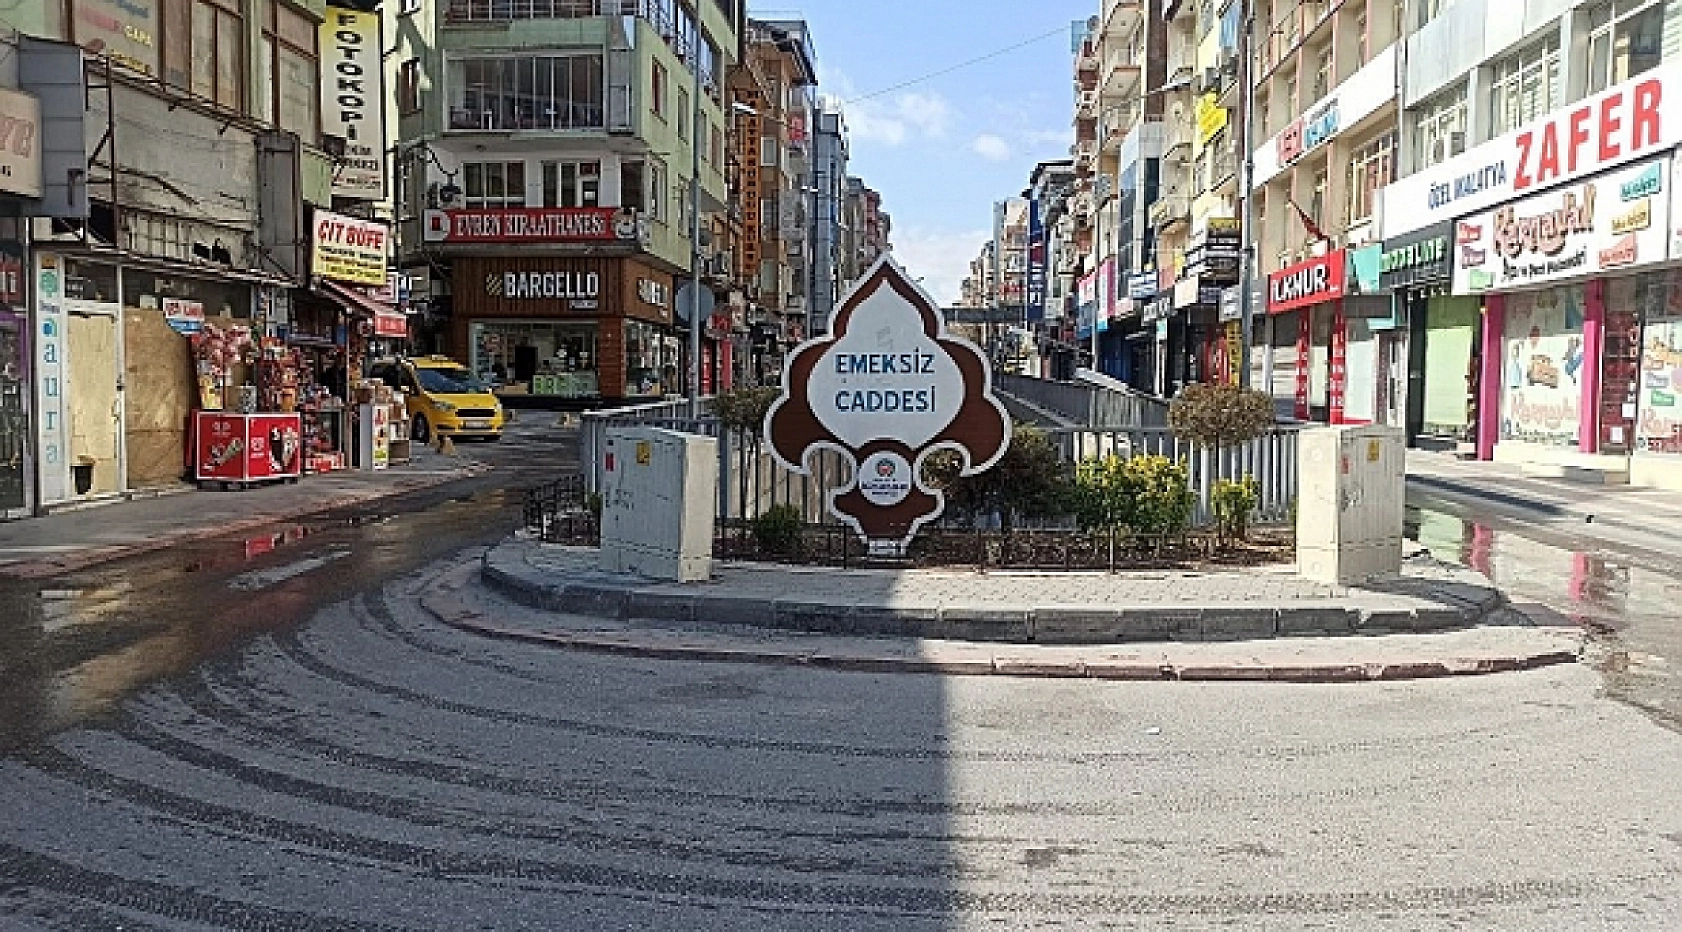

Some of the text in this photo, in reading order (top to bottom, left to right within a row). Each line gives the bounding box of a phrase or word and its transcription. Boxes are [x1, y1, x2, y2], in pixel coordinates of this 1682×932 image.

[1513, 78, 1663, 191] ZAFER
[1428, 160, 1507, 209] ÖZEL MALATYA
[503, 271, 599, 299] BARGELLO
[835, 346, 935, 374] EMEKSİZ
